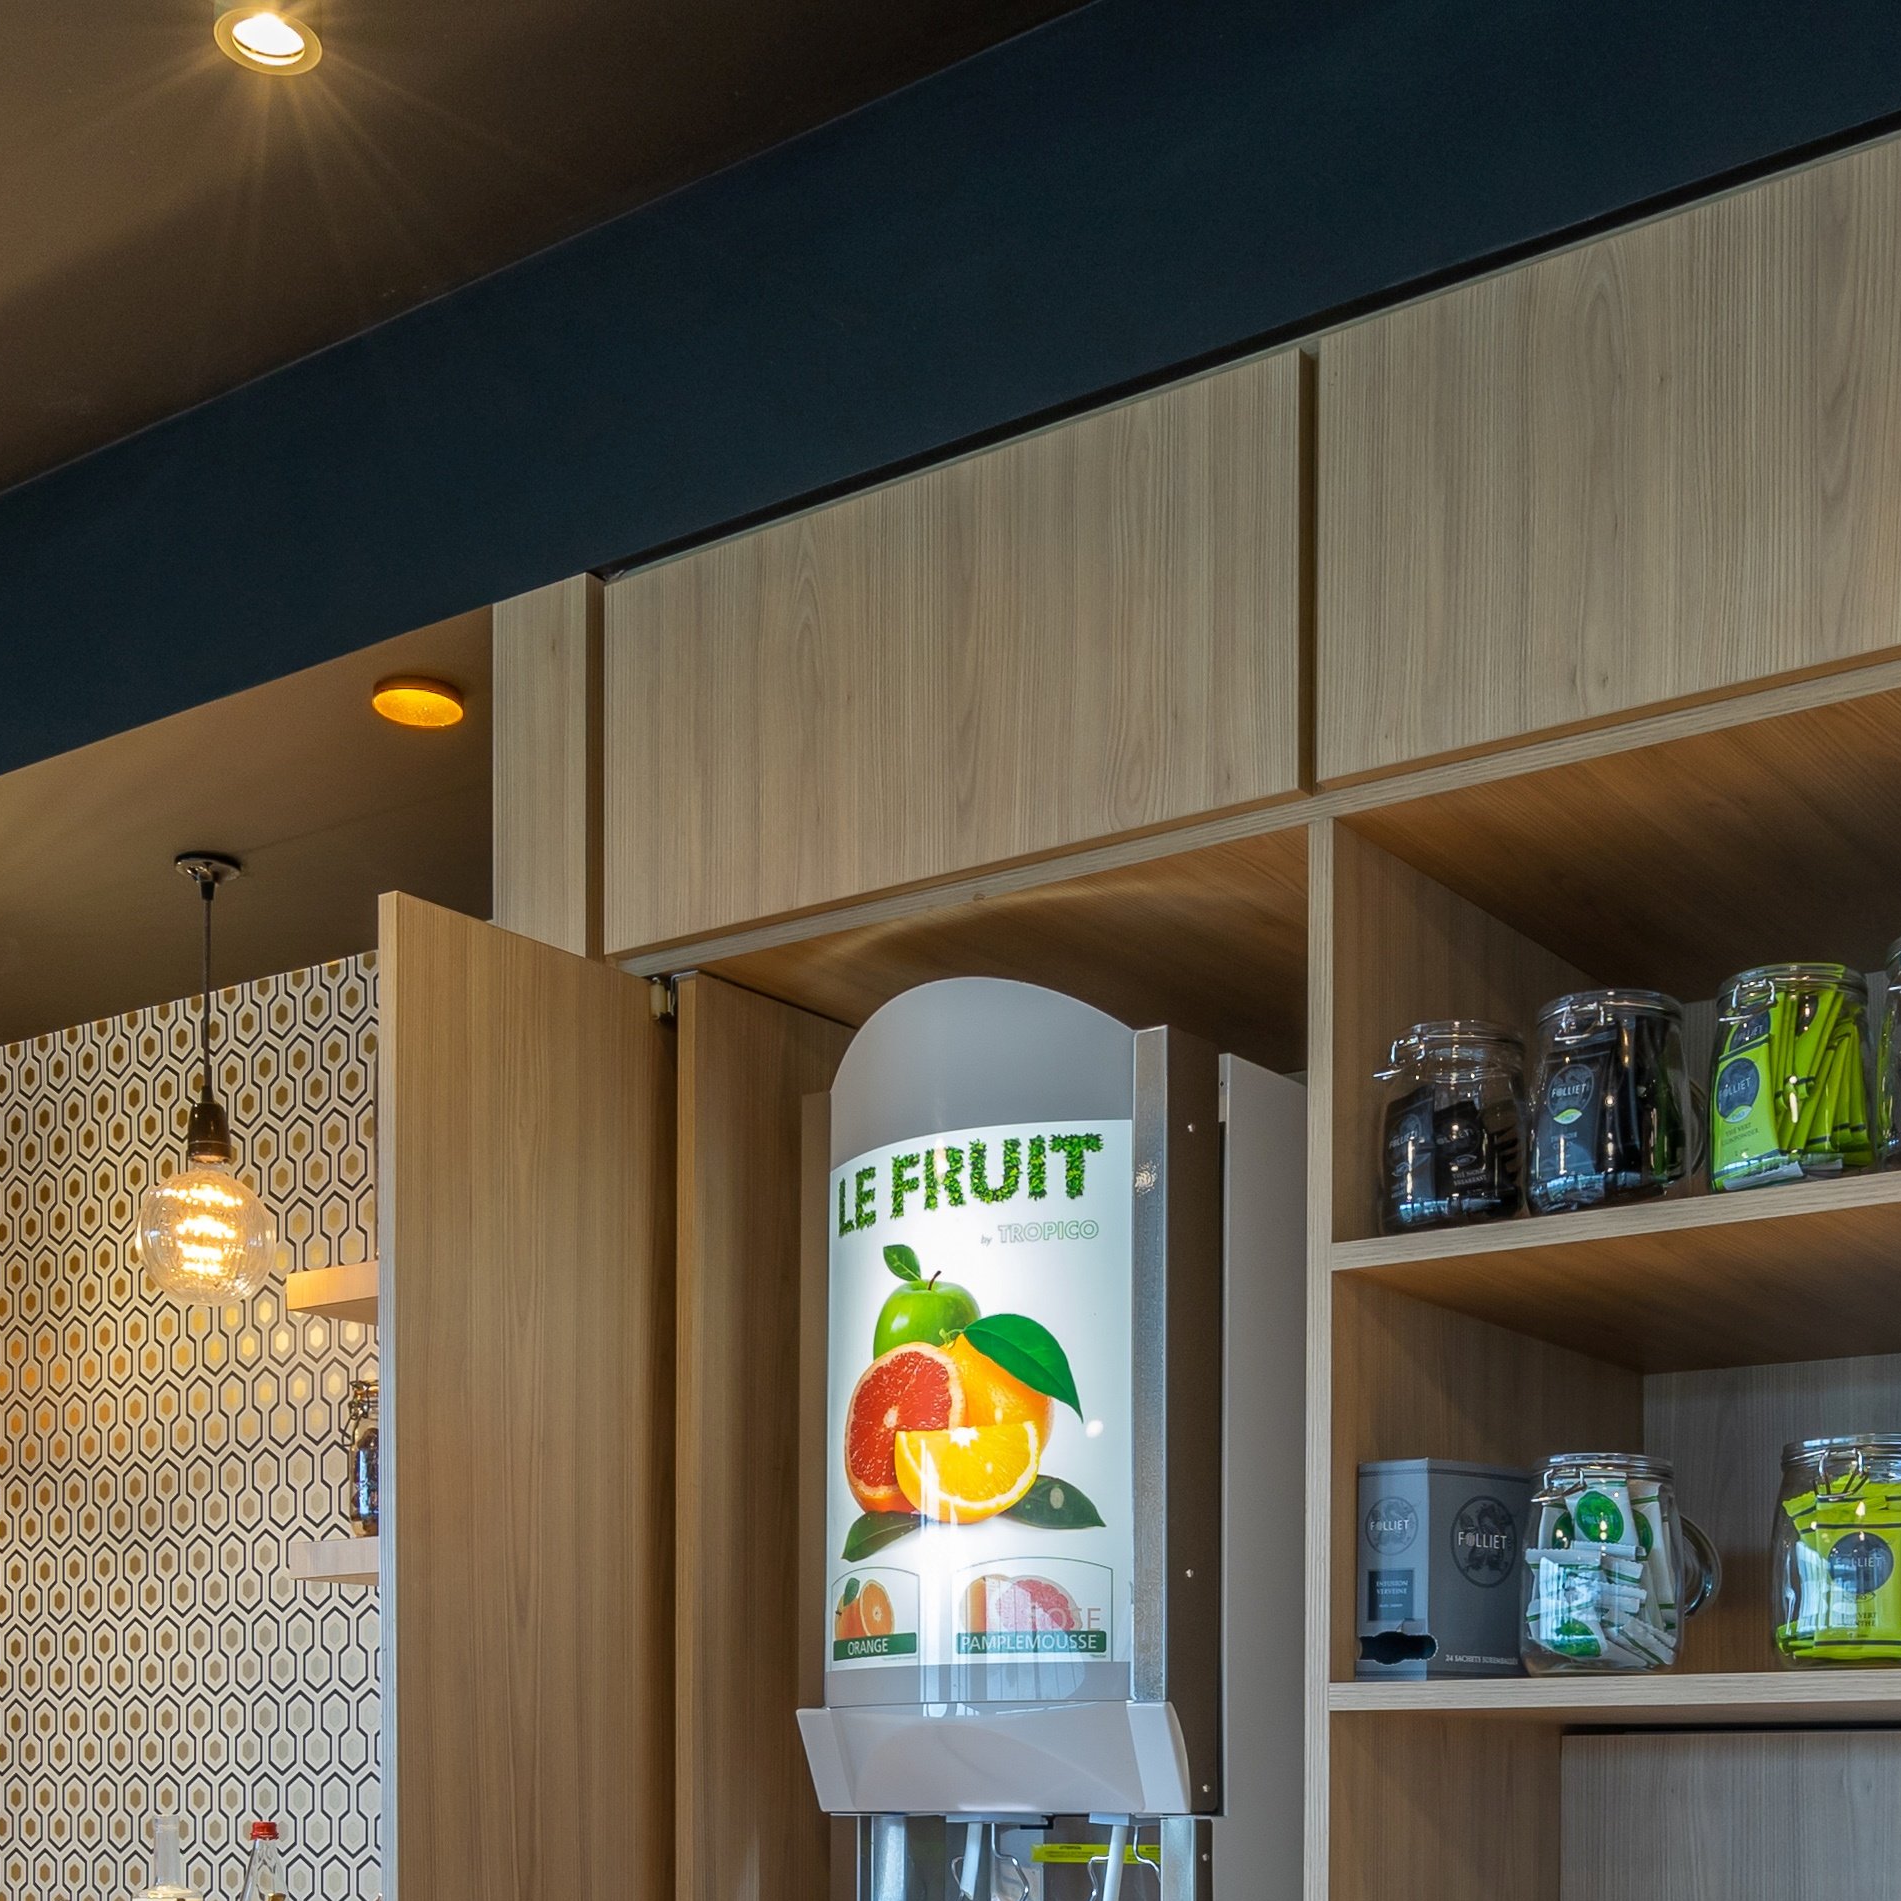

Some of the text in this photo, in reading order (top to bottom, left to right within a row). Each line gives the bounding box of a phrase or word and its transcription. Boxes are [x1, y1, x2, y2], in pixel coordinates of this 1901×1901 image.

[1551, 1083, 1587, 1098] FOLLIET
[838, 1133, 1104, 1237] LE FRUIT
[981, 1220, 1099, 1246] by TROPICO
[1370, 1519, 1409, 1531] FOLLIET
[1458, 1531, 1508, 1550] FOLLIET
[847, 1638, 889, 1656] ORANGE
[961, 1633, 1098, 1650] PAMPLEMOUSSE
